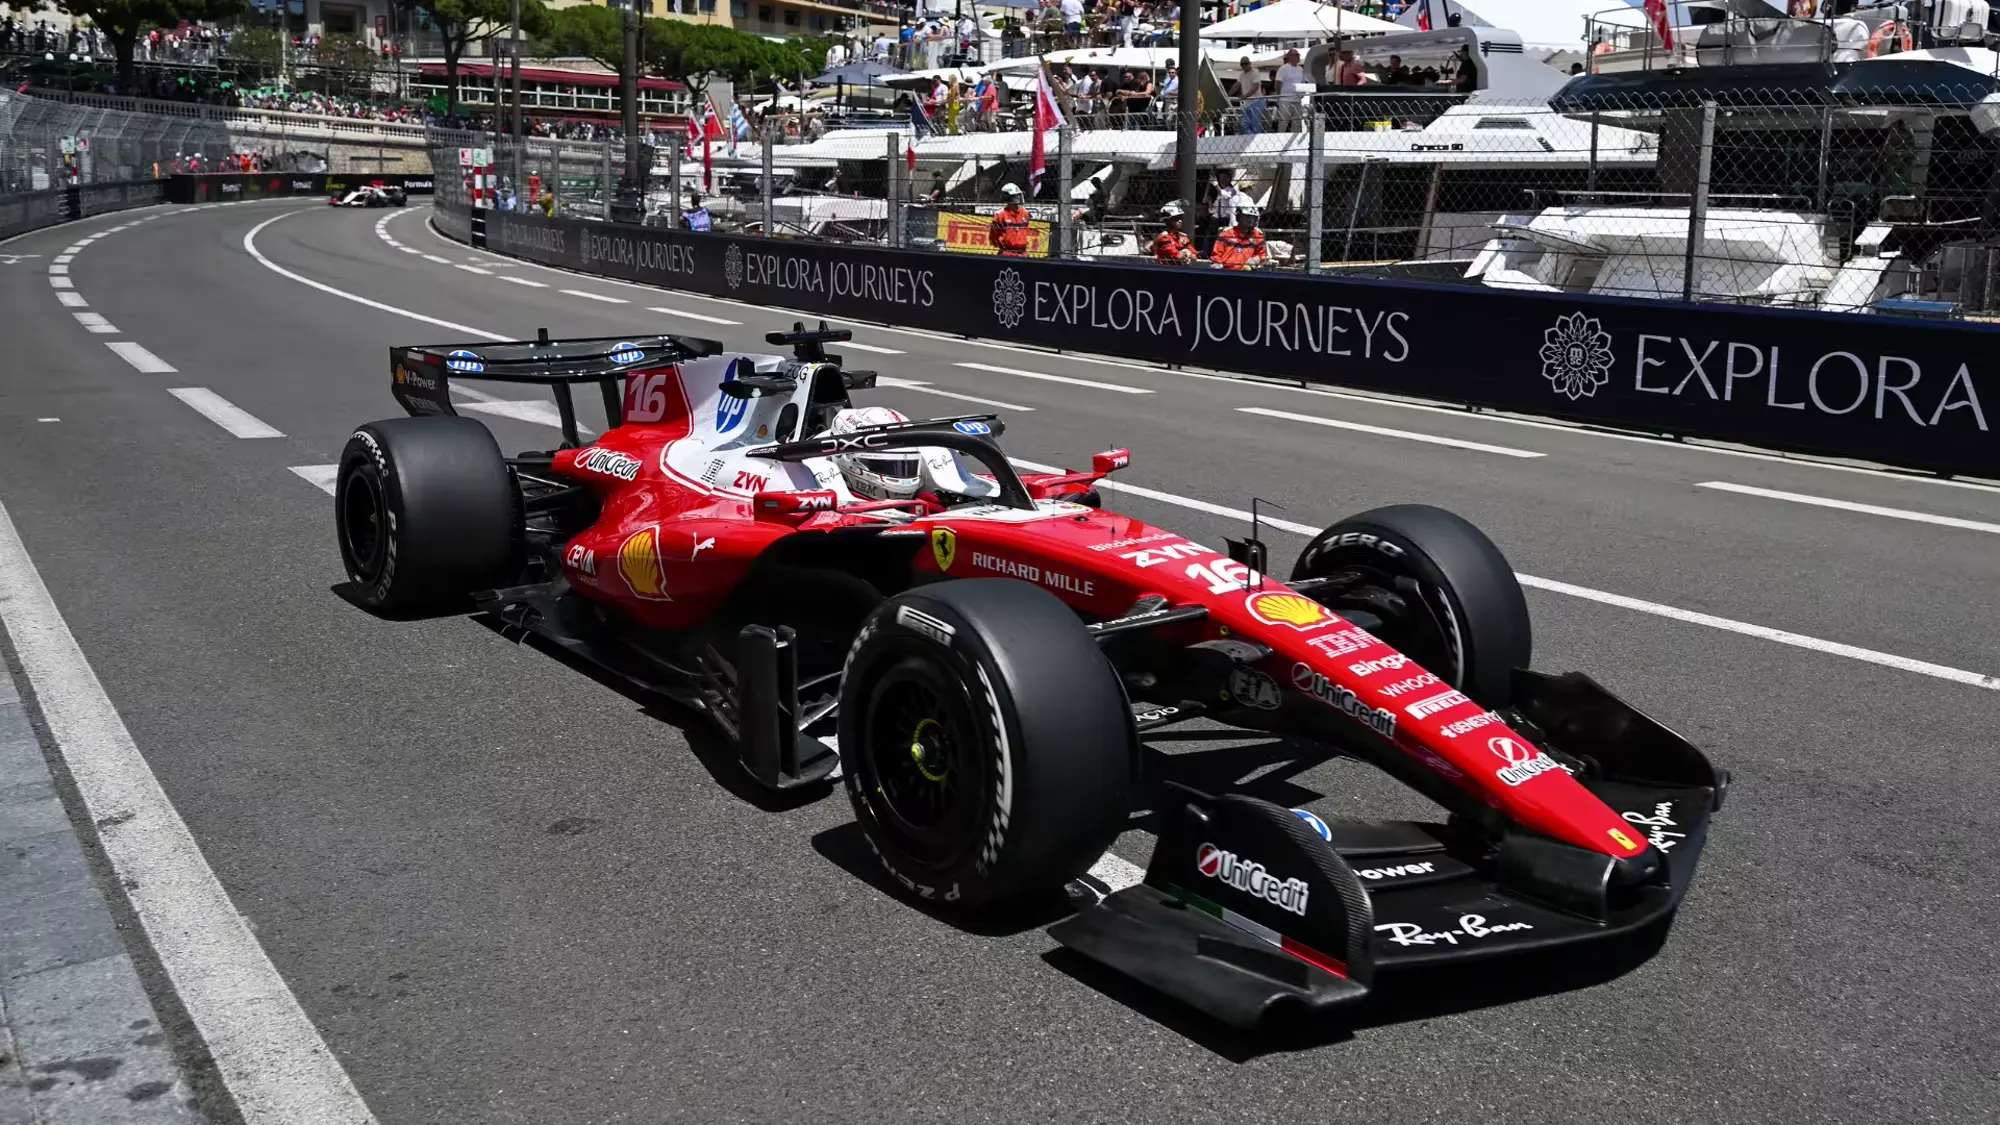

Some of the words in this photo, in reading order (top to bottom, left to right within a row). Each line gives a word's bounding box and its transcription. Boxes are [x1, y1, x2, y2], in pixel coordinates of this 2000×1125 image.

[947, 221, 1039, 251] PIRI
[591, 235, 634, 267] EXPLORA
[636, 241, 695, 274] JOURNEYS
[747, 253, 824, 292] EXPLORA
[828, 261, 934, 306] JOURNEYS
[1034, 282, 1182, 337] EXPLORA
[1190, 295, 1411, 362] JOURNEYS
[627, 374, 667, 422] 16
[1635, 334, 1989, 431] EXPLORA
[821, 433, 888, 453] DXC
[588, 450, 643, 481] UniCredit
[733, 470, 768, 493] ZYN
[798, 496, 832, 509] ZYN
[855, 480, 878, 495] IBM
[1088, 532, 1180, 552] Bitdefender
[1119, 542, 1217, 568] ZYN
[1322, 531, 1408, 559] ZERO
[567, 544, 596, 575] CEVA
[972, 552, 1039, 582] RICHARD
[1044, 571, 1094, 597] MILLE
[1185, 558, 1261, 595] 16
[1305, 627, 1385, 659] IBM
[1312, 671, 1397, 739] UniCredit
[1404, 690, 1472, 721] PIRELLI
[1496, 751, 1575, 787] UniCredit
[1219, 850, 1309, 916] UniCredit
[1373, 914, 1533, 946] Ray-Ban
